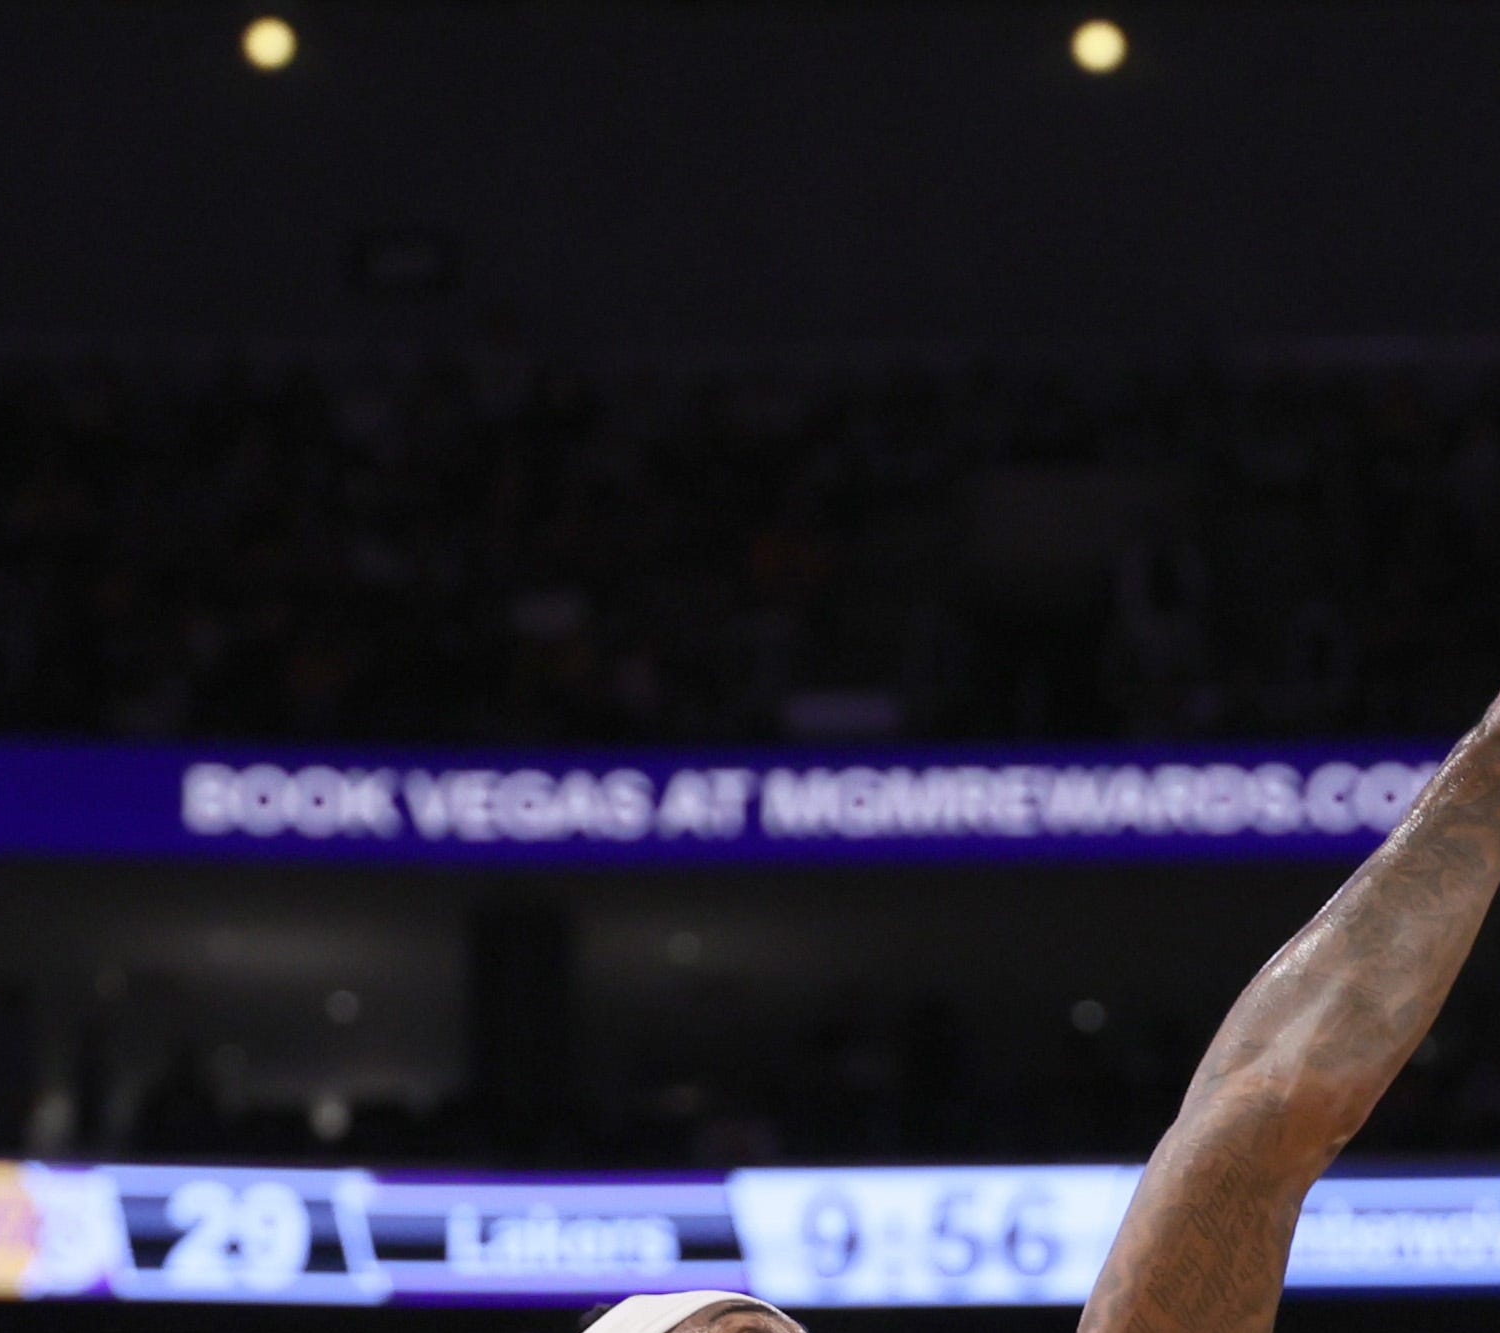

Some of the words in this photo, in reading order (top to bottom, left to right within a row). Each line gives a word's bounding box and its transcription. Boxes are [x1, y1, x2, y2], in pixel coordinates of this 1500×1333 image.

[181, 762, 402, 839] BOOK
[404, 768, 655, 843] VEGAS
[658, 768, 754, 838] AT
[162, 1180, 310, 1292] 29
[444, 1200, 682, 1277] Lakers
